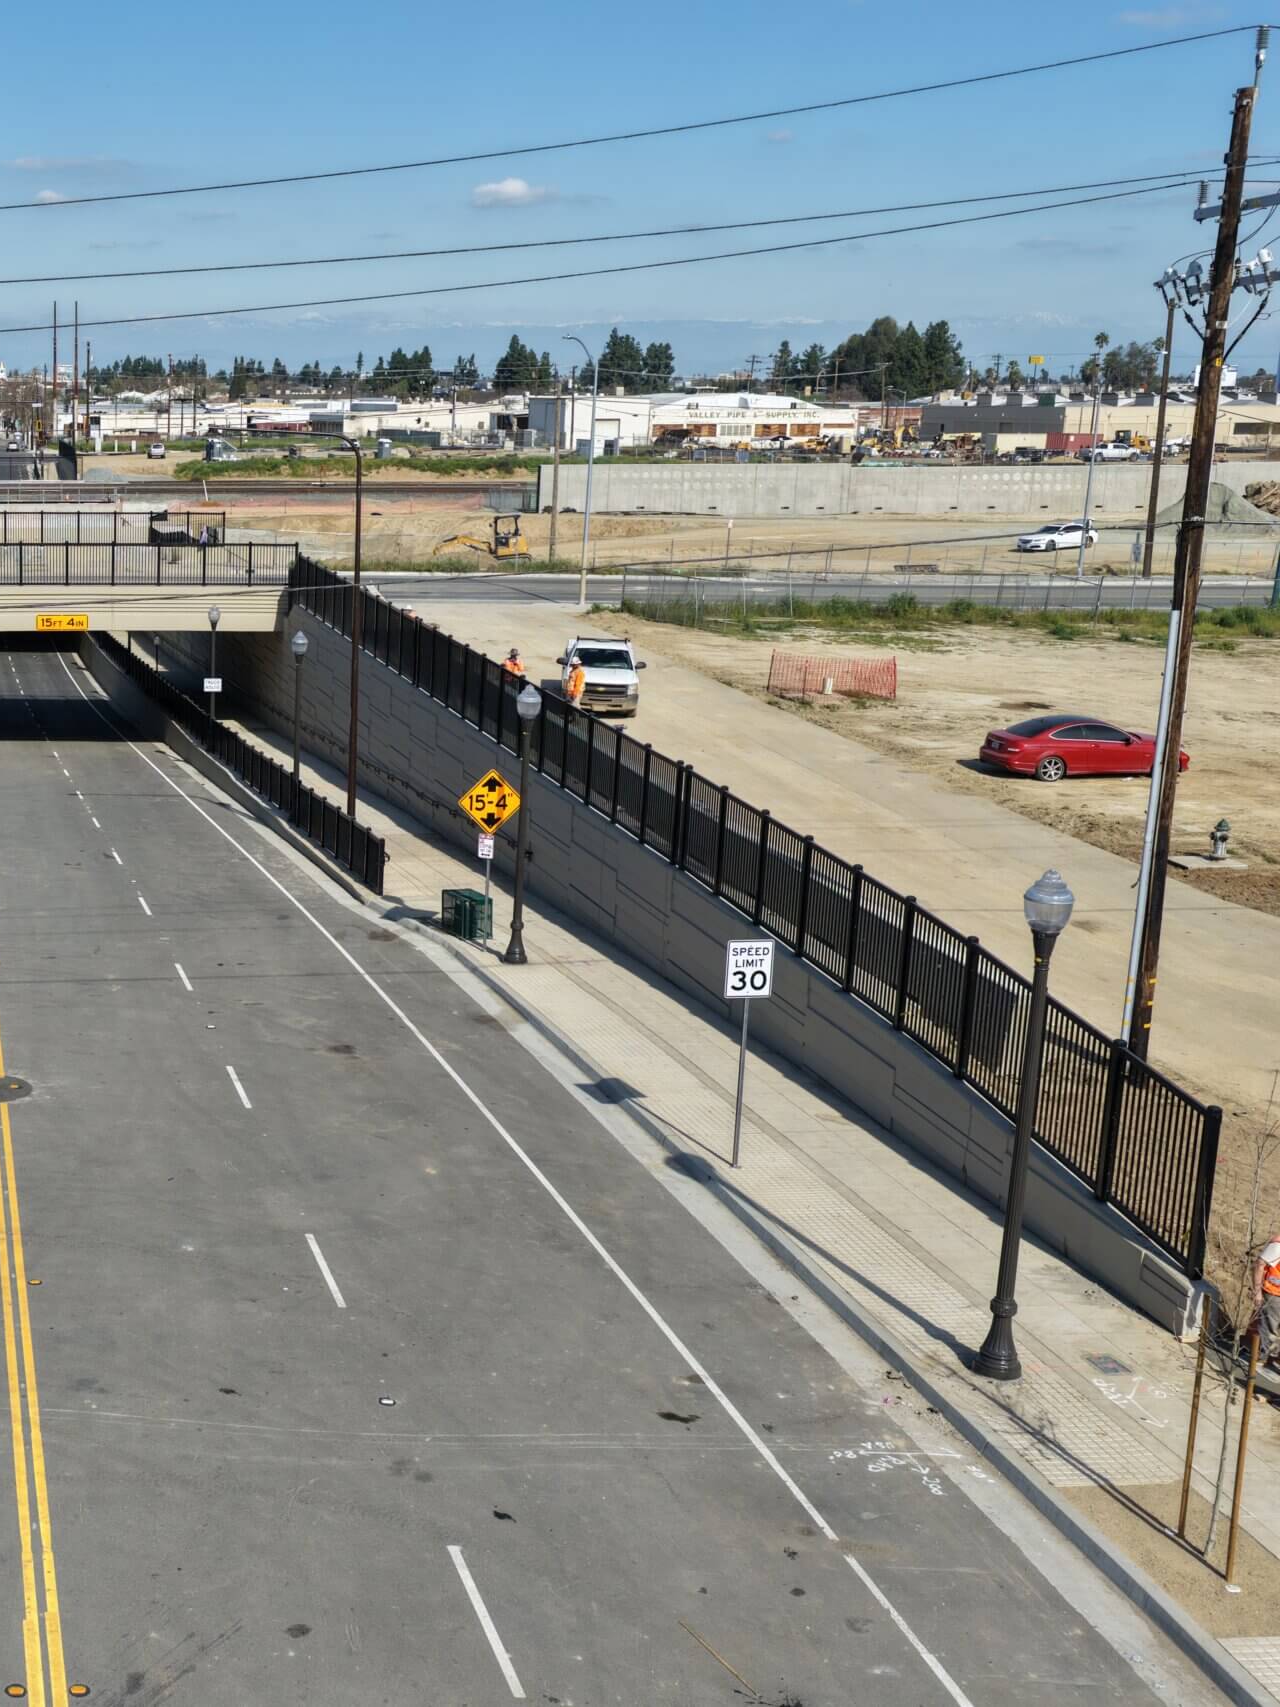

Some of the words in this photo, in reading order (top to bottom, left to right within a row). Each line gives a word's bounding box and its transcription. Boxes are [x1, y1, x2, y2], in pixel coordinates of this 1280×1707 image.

[732, 947, 770, 956] SPEED
[735, 958, 765, 968] LIMIT
[731, 970, 767, 991] 30
